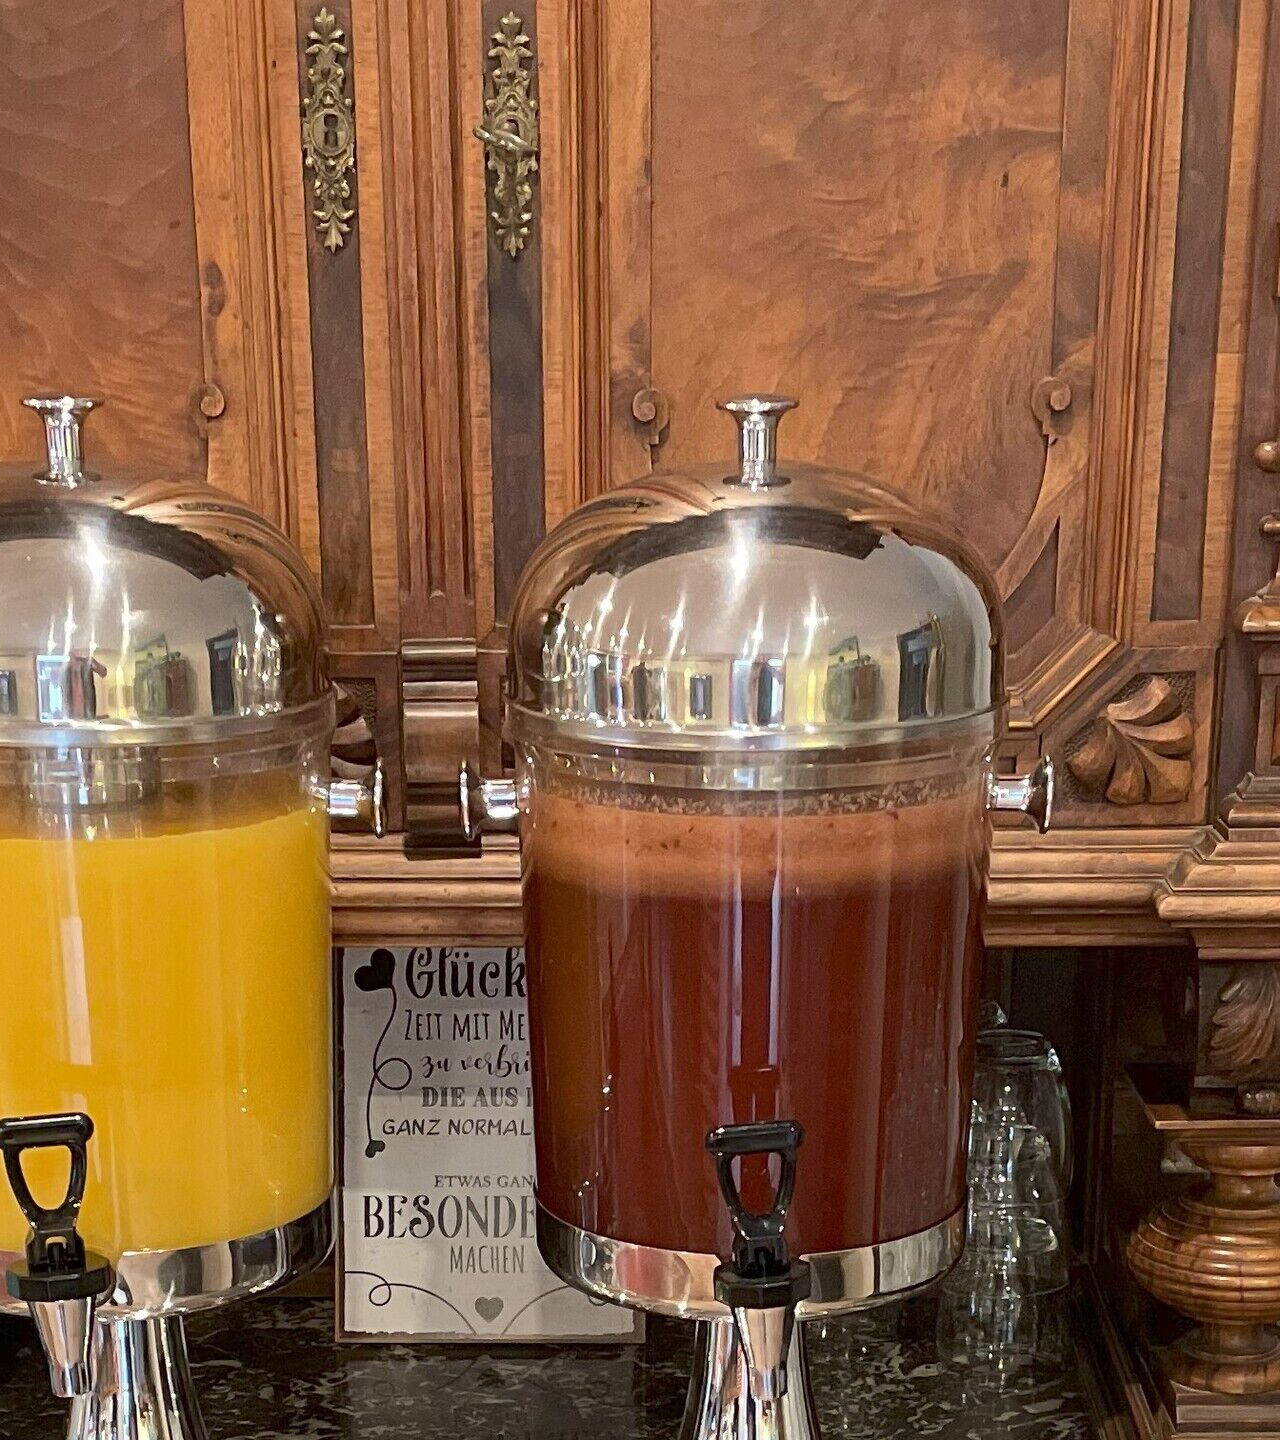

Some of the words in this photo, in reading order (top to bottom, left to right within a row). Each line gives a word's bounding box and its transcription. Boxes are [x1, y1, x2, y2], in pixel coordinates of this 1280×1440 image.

[406, 946, 527, 999] Glück
[404, 1009, 443, 1041] ZEIT
[452, 1012, 491, 1043] MIT
[421, 1055, 452, 1079] zu
[421, 1086, 465, 1108] DIE
[472, 1086, 519, 1108] AUS
[382, 1118, 441, 1136] GANZ
[447, 1118, 533, 1136] NORMAL
[433, 1174, 492, 1189] ETWAS
[449, 1244, 525, 1274] MACHEN
